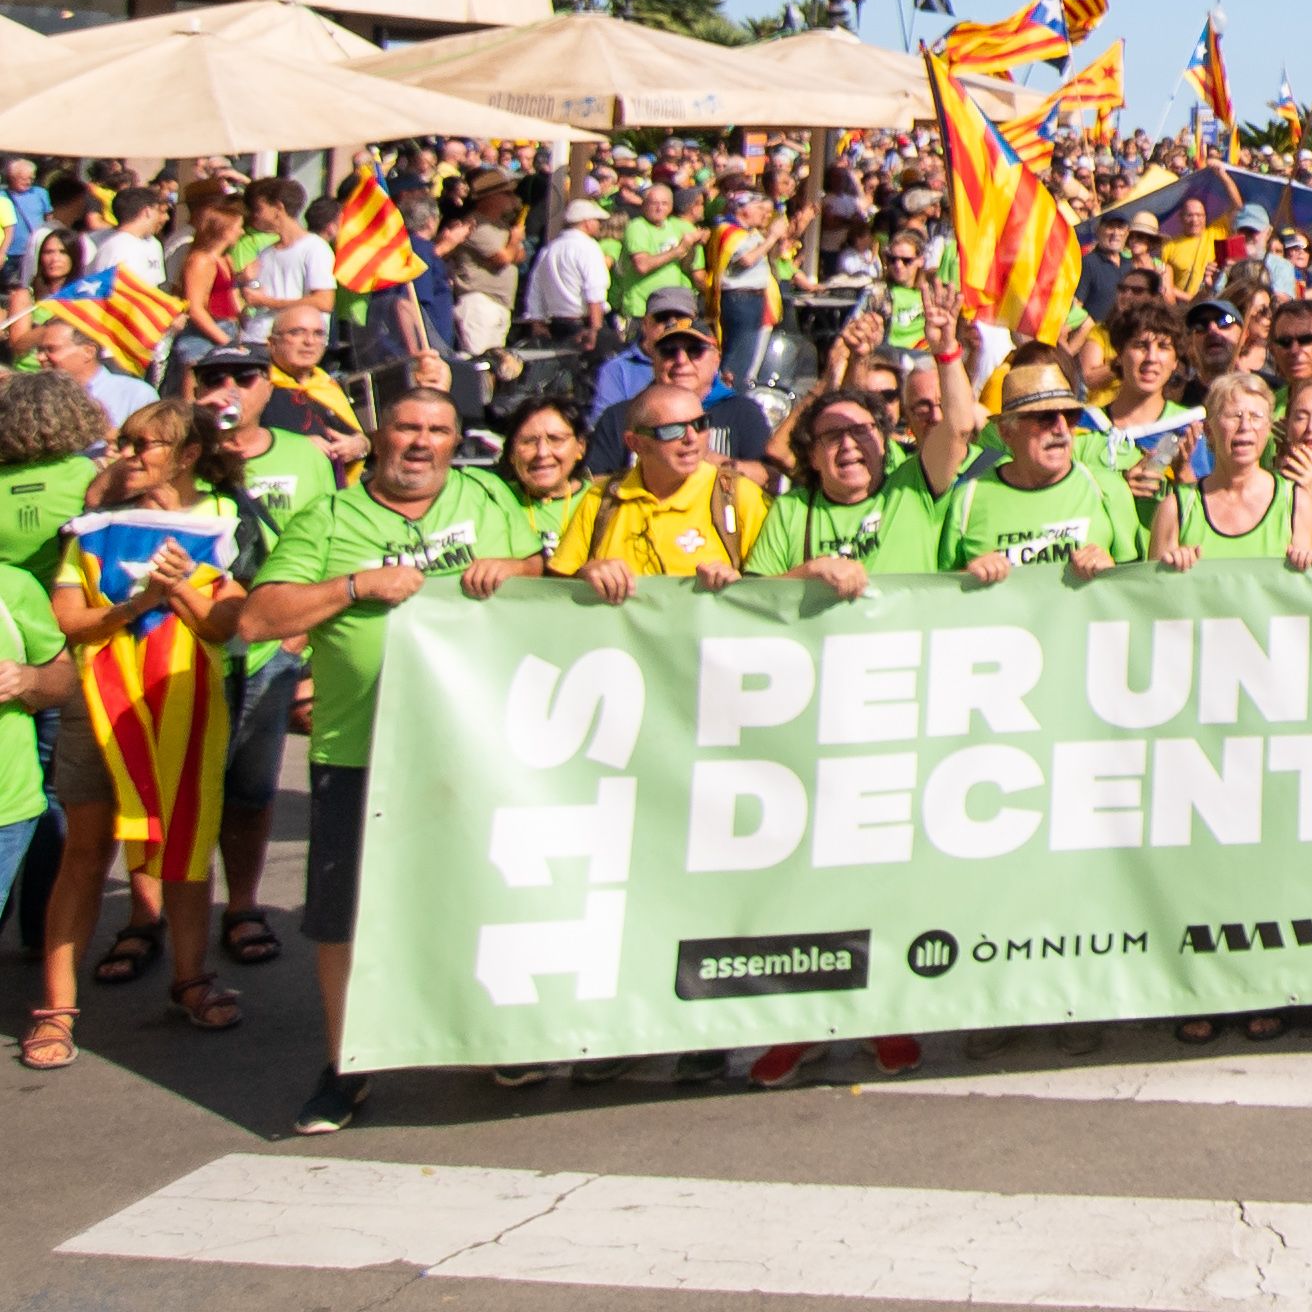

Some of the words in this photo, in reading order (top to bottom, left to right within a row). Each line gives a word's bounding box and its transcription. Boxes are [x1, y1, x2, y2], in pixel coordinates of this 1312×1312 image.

[997, 531, 1034, 546] FEM
[697, 625, 1044, 748] PER
[475, 648, 646, 1006] 11S
[699, 946, 853, 980] assemblea
[971, 931, 1150, 963] ÒMNIUM
